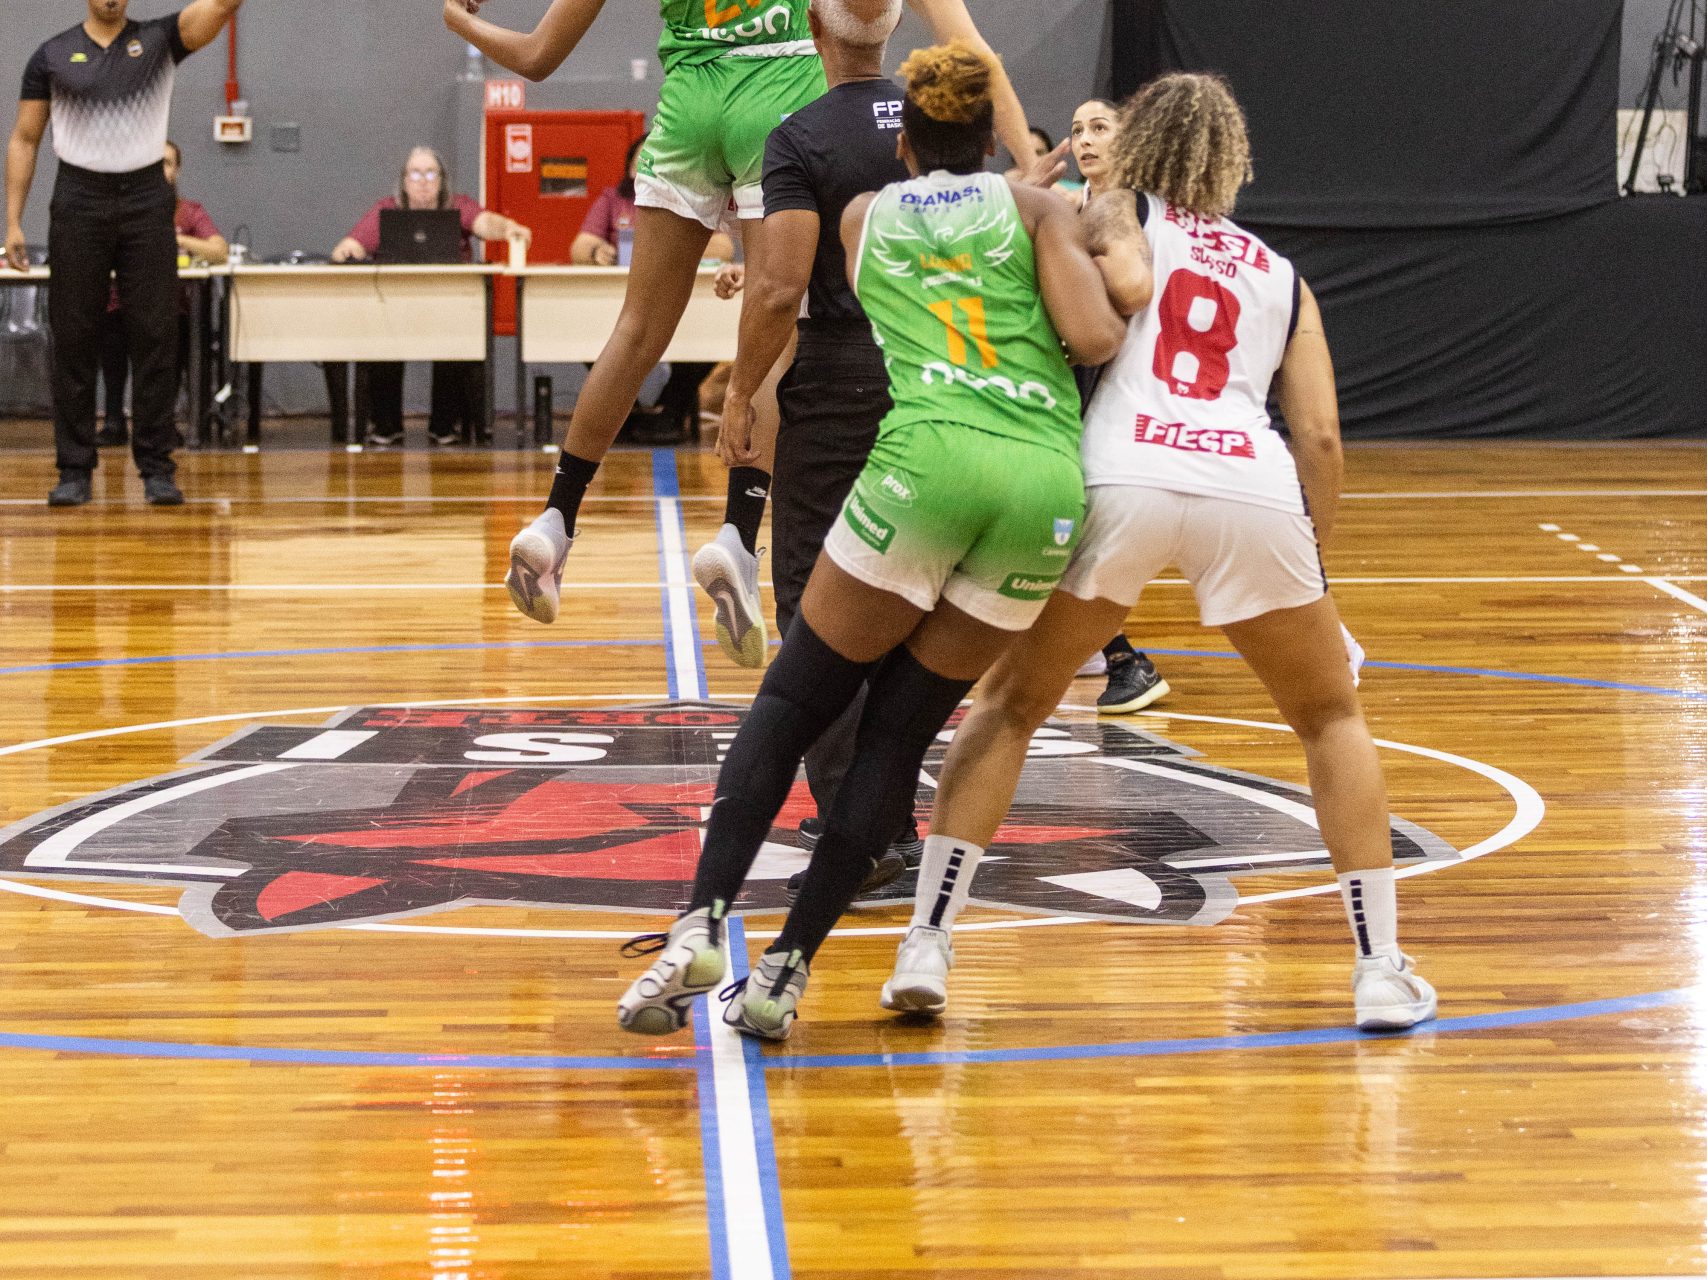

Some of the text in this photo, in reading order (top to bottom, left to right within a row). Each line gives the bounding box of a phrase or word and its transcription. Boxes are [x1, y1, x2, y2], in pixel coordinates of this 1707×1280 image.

[872, 99, 905, 117] FP
[927, 296, 999, 369] 11
[1152, 267, 1241, 402] 8
[1144, 419, 1246, 454] FIESP
[881, 474, 911, 498] prox
[850, 495, 889, 541] Unimed
